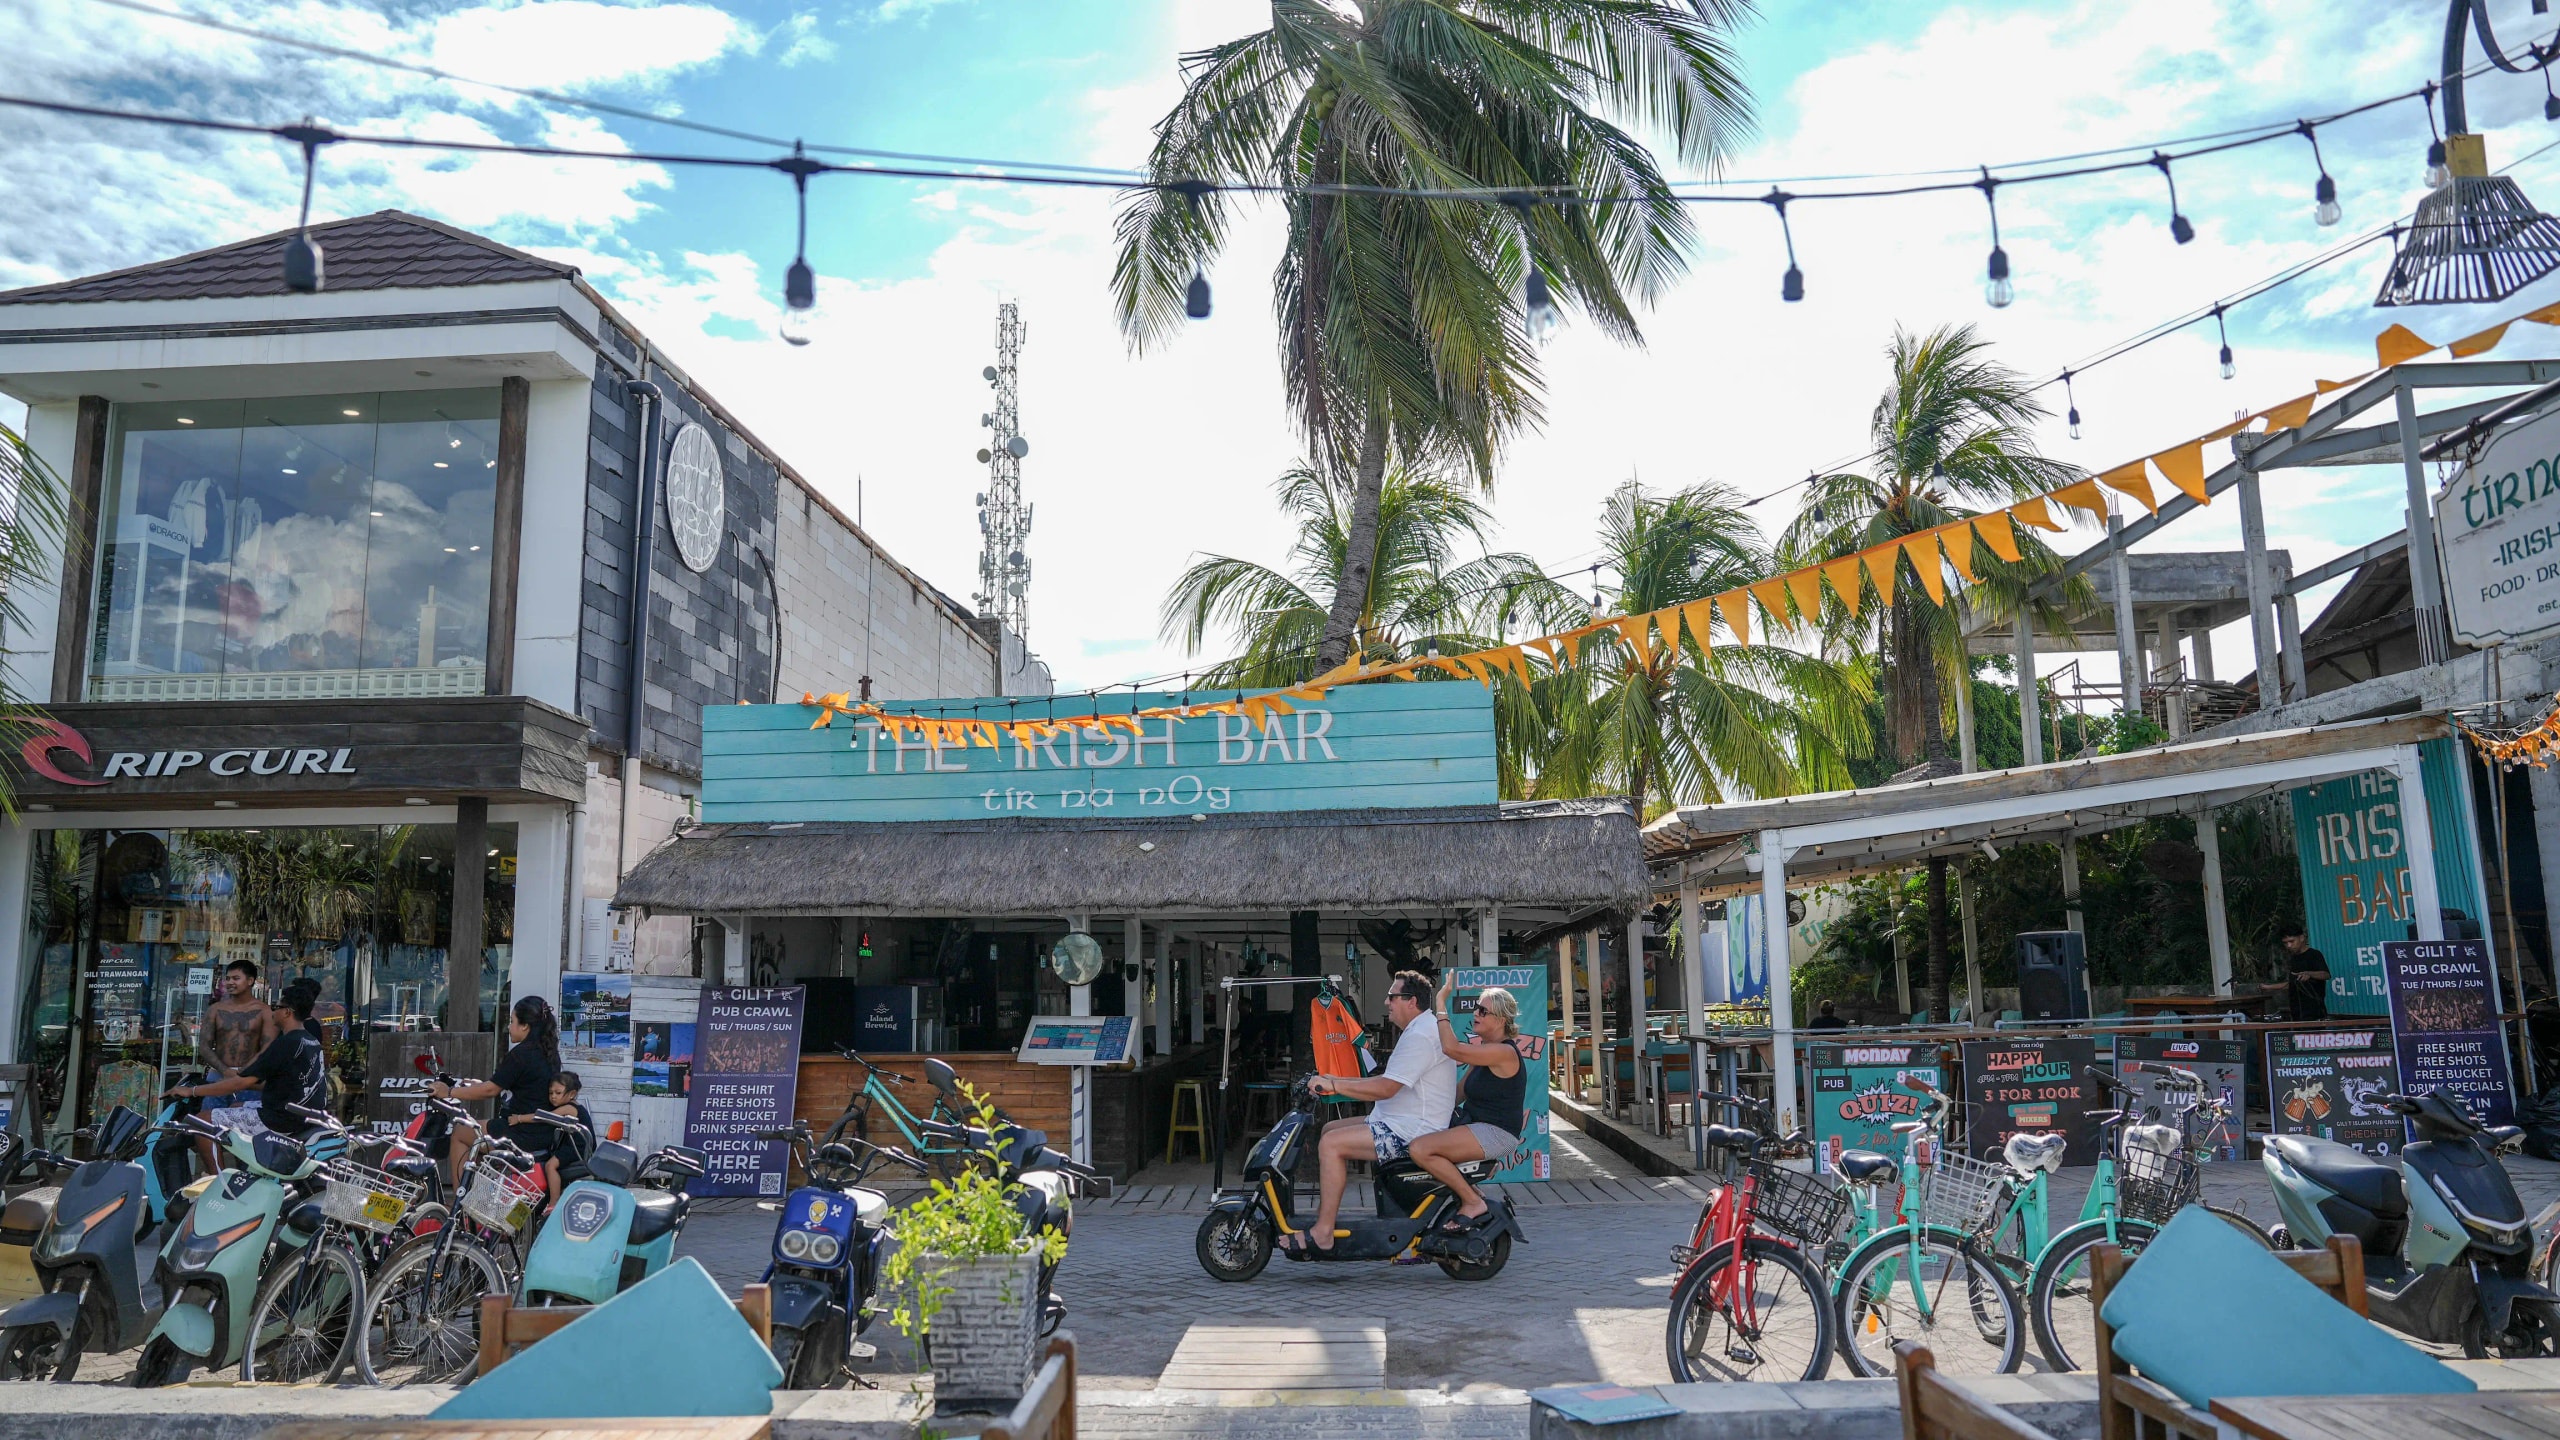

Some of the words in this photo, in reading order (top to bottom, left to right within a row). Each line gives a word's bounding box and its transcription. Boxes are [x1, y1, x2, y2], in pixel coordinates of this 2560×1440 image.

[156, 525, 188, 544] DRAGON
[2480, 574, 2525, 602] FOOD
[855, 720, 969, 774] THE
[1014, 712, 1177, 769] IRISH
[1216, 708, 1340, 765] BAR
[103, 750, 204, 778] RIP
[209, 748, 357, 776] CURL
[1061, 787, 1114, 808] na
[2316, 802, 2408, 867] IRIS
[2414, 946, 2444, 958] GILI
[2446, 945, 2457, 956] T
[2400, 964, 2428, 975] PUB
[2431, 963, 2480, 974] CRAWL
[2426, 980, 2457, 988] THURS
[2464, 980, 2484, 988] SUN
[730, 988, 760, 1000] GILI
[764, 988, 774, 1000] T
[712, 1006, 740, 1016] PUB
[744, 1006, 792, 1016] CRAWL
[1461, 1000, 1480, 1010] PU
[865, 1022, 898, 1030] Brewing
[2294, 1032, 2375, 1048] THURSDAY
[2417, 1044, 2446, 1054] FREE
[2448, 1042, 2482, 1052] SHIRT
[1988, 1052, 2040, 1066] HAPPY
[2280, 1056, 2330, 1066] THIRSTY
[2337, 1056, 2392, 1068] TONIGHT
[2416, 1056, 2446, 1067] FREE
[2448, 1056, 2487, 1066] SHOTS
[2022, 1063, 2070, 1078] HOUR
[2276, 1066, 2334, 1077] THURSDAYS
[2415, 1070, 2444, 1080] FREE
[2446, 1068, 2492, 1079] BUCKET
[380, 1078, 416, 1088] RIP
[1896, 1070, 1906, 1084] 8
[709, 1085, 738, 1094] FREE
[740, 1085, 774, 1094] SHIRT
[1824, 1080, 1844, 1088] PUB
[2447, 1081, 2504, 1092] SPECIALS
[1984, 1090, 1994, 1102] 3
[1999, 1088, 2032, 1101] FOR
[2038, 1086, 2081, 1099] 100K
[2164, 1092, 2196, 1104] LIVE
[705, 1098, 733, 1108] FREE
[736, 1098, 775, 1108] SHOTS
[1840, 1094, 1920, 1120] QUIZ!
[2476, 1098, 2492, 1108] IN
[700, 1111, 728, 1120] FREE
[731, 1111, 778, 1120] BUCKET
[690, 1124, 727, 1134] DRINK
[730, 1124, 785, 1134] SPECIALS
[2344, 1128, 2396, 1139] CHECK-IN
[703, 1140, 750, 1151] CHECK
[754, 1140, 768, 1151] IN
[1857, 1134, 1868, 1146] 2
[1872, 1132, 1890, 1150] for
[708, 1154, 760, 1170] HERE
[711, 1173, 754, 1184] 7-9PM
